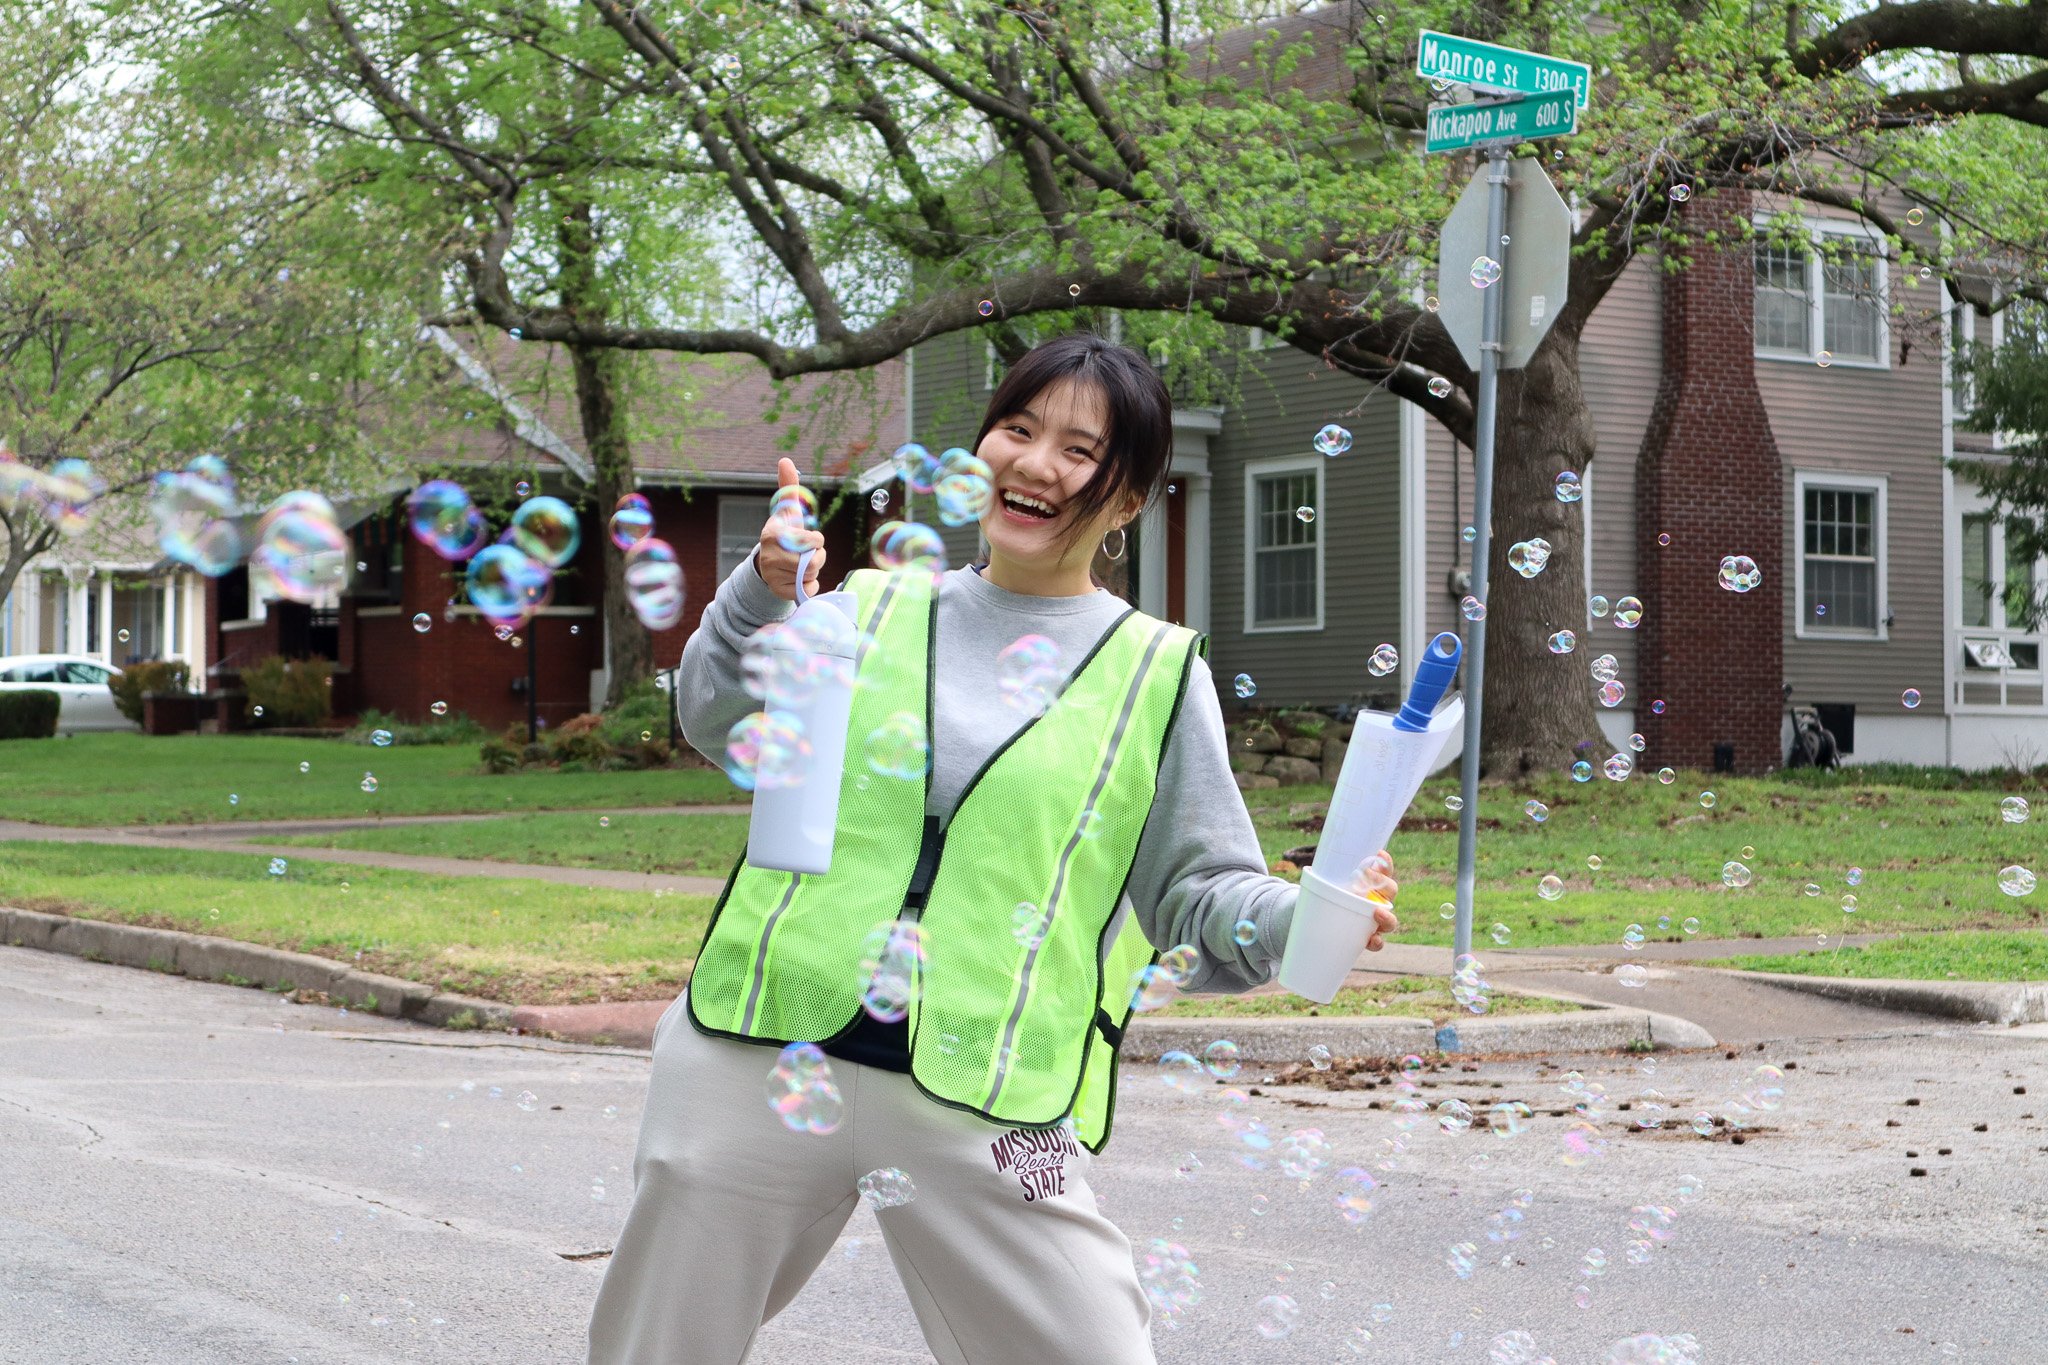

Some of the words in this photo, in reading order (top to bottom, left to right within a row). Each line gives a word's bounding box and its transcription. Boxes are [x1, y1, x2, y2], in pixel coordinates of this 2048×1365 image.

[1423, 38, 1496, 83] Monroe
[1503, 63, 1519, 88] St
[1535, 66, 1569, 91] 1300
[1429, 110, 1492, 143] Kickapoo
[1496, 109, 1518, 132] Ave
[1536, 101, 1559, 127] 600
[1563, 100, 1572, 124] S
[1013, 1151, 1065, 1174] Bears
[1019, 1166, 1065, 1202] STATE
